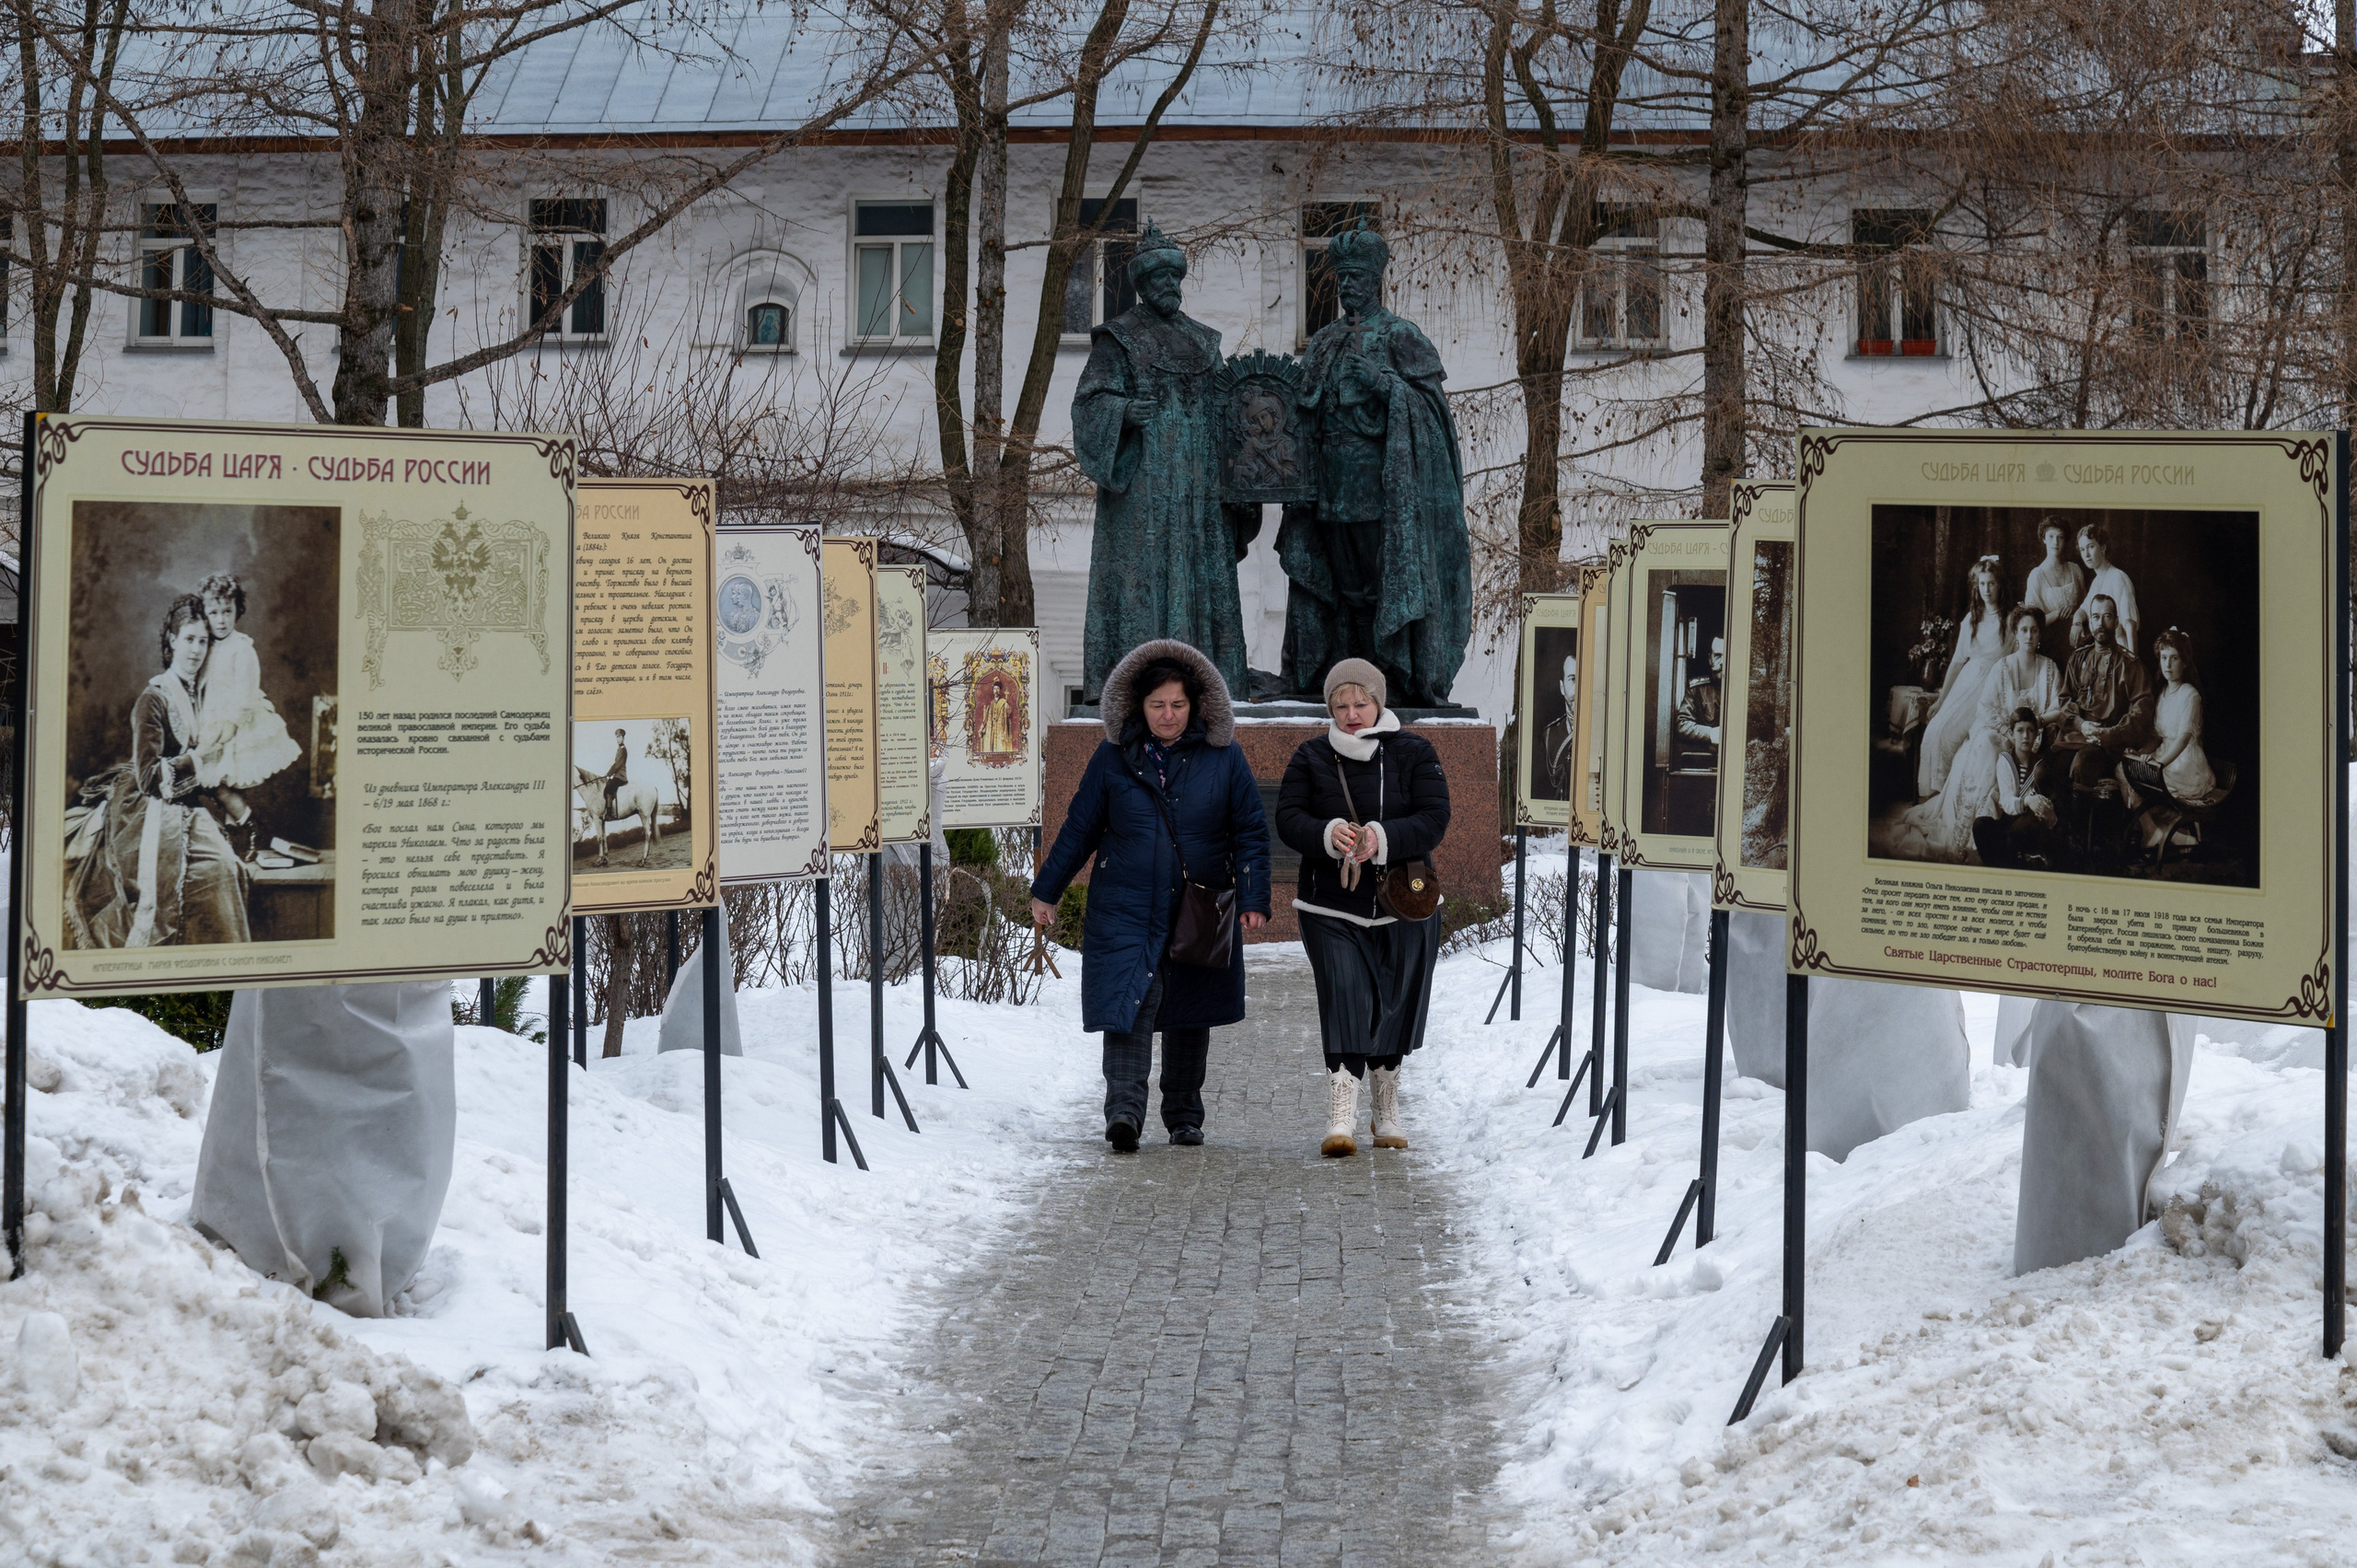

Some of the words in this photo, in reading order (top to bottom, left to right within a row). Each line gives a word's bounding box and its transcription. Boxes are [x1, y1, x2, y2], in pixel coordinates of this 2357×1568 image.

[122, 450, 212, 478] СУДЬБА
[224, 454, 281, 479] ЦАРЯ
[308, 456, 394, 483] СУДЬБА
[405, 459, 491, 484] РОССИИ
[1922, 462, 1979, 482] СУДЬБА
[1987, 463, 2026, 482] ЦАРЯ
[2064, 464, 2123, 484] СУДЬБА
[2131, 465, 2194, 485] РОССИИ
[595, 505, 639, 519] РОССИИ
[621, 532, 640, 540] Князя
[651, 532, 691, 540] Константина
[1647, 542, 1681, 554] СУДЬБА
[1687, 543, 1709, 553] ЦАРЯ
[606, 579, 640, 588] Торжество
[644, 578, 658, 587] было
[359, 712, 374, 720] 150
[419, 713, 452, 721] родился
[455, 711, 497, 719] последний
[500, 711, 551, 721] Самодержец
[399, 723, 455, 733] православной
[461, 724, 497, 732] империи.
[505, 722, 517, 730] Его
[524, 721, 550, 733] судьба
[409, 736, 438, 744] кровно
[448, 734, 489, 742] связанной
[514, 733, 550, 743] судьбами
[357, 746, 414, 756] исторической
[365, 784, 377, 793] Из
[379, 783, 419, 796] дневника
[423, 783, 478, 795] Императора
[481, 782, 528, 793] Александра
[533, 781, 545, 789] III
[374, 798, 392, 809] 6/19
[418, 797, 438, 807] 1868
[363, 824, 381, 833] «Бог
[452, 821, 476, 831] Сына,
[485, 823, 523, 833] которого
[363, 842, 397, 852] нарекли
[401, 838, 447, 847] Николаем.
[452, 837, 470, 846] Что
[487, 838, 520, 849] радость
[525, 835, 544, 844] была
[445, 852, 460, 862] себе
[471, 851, 528, 864] представить.
[539, 850, 544, 858] Я
[363, 870, 400, 882] бросился
[408, 868, 450, 877] обнимать
[483, 868, 510, 878] душку
[521, 867, 543, 877] жену,
[362, 887, 399, 897] которая
[412, 886, 436, 896] разом
[450, 882, 493, 891] повеселела
[524, 880, 544, 889] была
[362, 900, 407, 911] счастлива
[411, 900, 445, 912] ужасно.
[448, 898, 455, 907] Я
[512, 898, 535, 908] дитя,
[382, 917, 406, 925] легко
[410, 914, 430, 923] было
[447, 915, 468, 925] душе
[481, 913, 523, 923] приятно».
[2068, 913, 2084, 922] была
[2128, 919, 2144, 928] убита
[2173, 924, 2197, 934] приказу
[2207, 925, 2249, 936] большевиков
[2154, 912, 2169, 920] 1918
[2204, 917, 2223, 925] семья
[2226, 918, 2264, 929] Императора
[2068, 923, 2114, 935] Екатеринбурге.
[2118, 928, 2138, 936] Россия
[2199, 937, 2239, 946] помазанника
[2243, 939, 2264, 947] Божия
[2068, 943, 2127, 957] братоубийственную
[2131, 950, 2148, 958] войну
[2157, 953, 2203, 962] воинствующий
[2077, 935, 2102, 945] обрекла
[2140, 942, 2176, 950] поражение,
[2207, 947, 2232, 957] нищету,
[2238, 950, 2263, 959] разруху,
[1884, 947, 1923, 959] Святые
[1929, 950, 2002, 967] Царственные
[2007, 958, 2096, 977] Страстотерпцы,
[2103, 969, 2142, 981] молите
[2149, 970, 2174, 983] Бога
[2180, 976, 2187, 984] о
[2193, 977, 2216, 988] нас!
